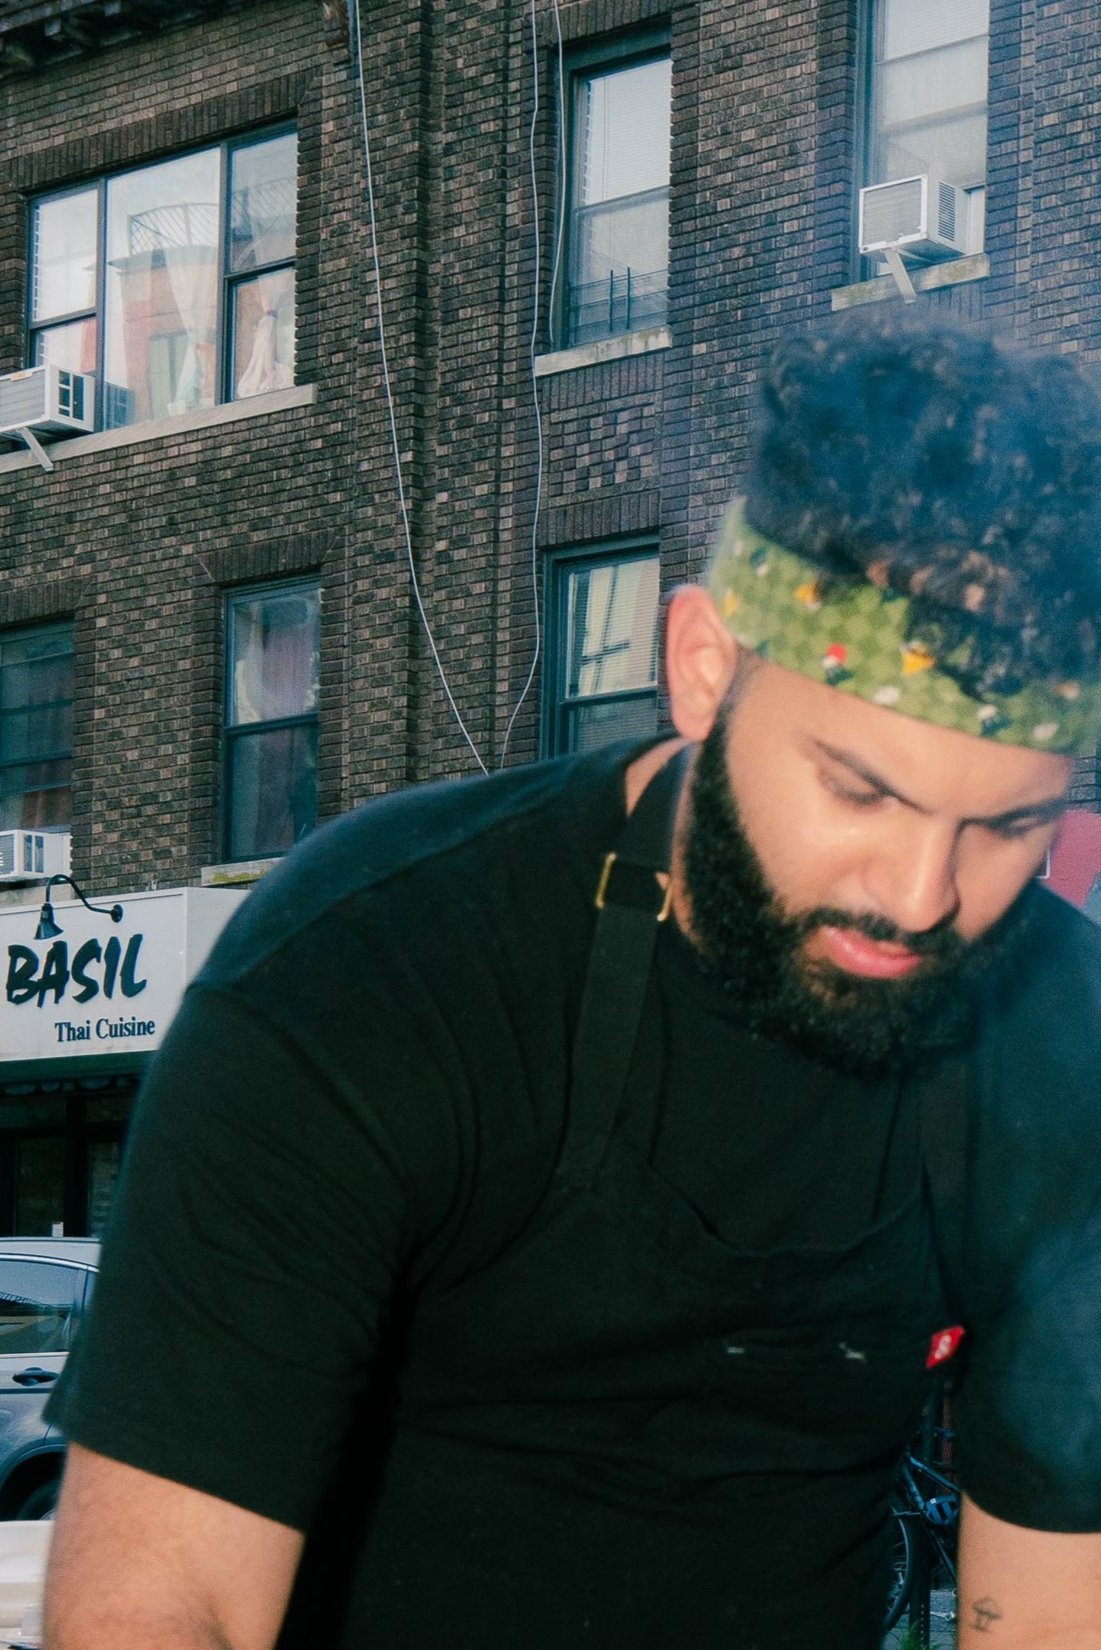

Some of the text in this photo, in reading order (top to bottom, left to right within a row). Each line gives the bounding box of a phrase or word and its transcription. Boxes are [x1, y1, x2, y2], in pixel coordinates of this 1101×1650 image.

[6, 934, 147, 1008] BASIL
[55, 1017, 156, 1042] Thai Cuisine
